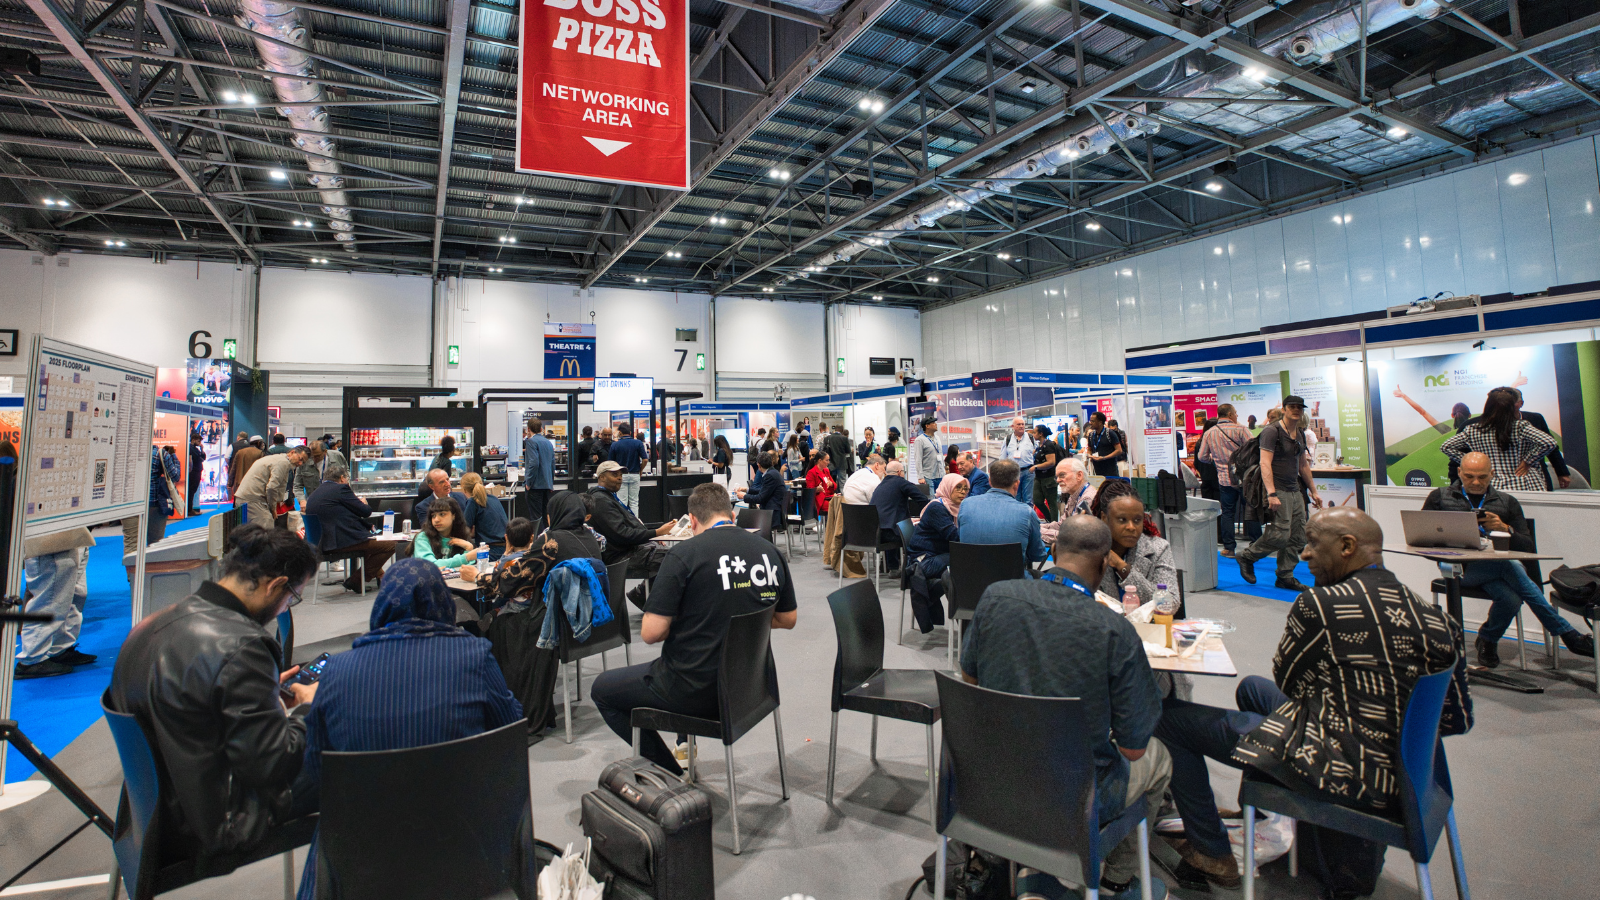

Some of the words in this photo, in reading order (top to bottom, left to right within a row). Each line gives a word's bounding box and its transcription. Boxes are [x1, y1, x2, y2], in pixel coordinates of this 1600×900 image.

[552, 16, 662, 68] PIZZA
[542, 82, 670, 116] NETWORKING
[582, 108, 633, 128] AREA
[188, 330, 212, 358] 6
[48, 356, 62, 366] 2025
[62, 360, 90, 372] FLOORPLAN
[674, 349, 688, 371] 7
[125, 374, 143, 384] EXHIBITOR
[193, 395, 223, 403] move
[949, 397, 984, 407] chicken
[0, 430, 20, 444] NS
[738, 580, 751, 588] need
